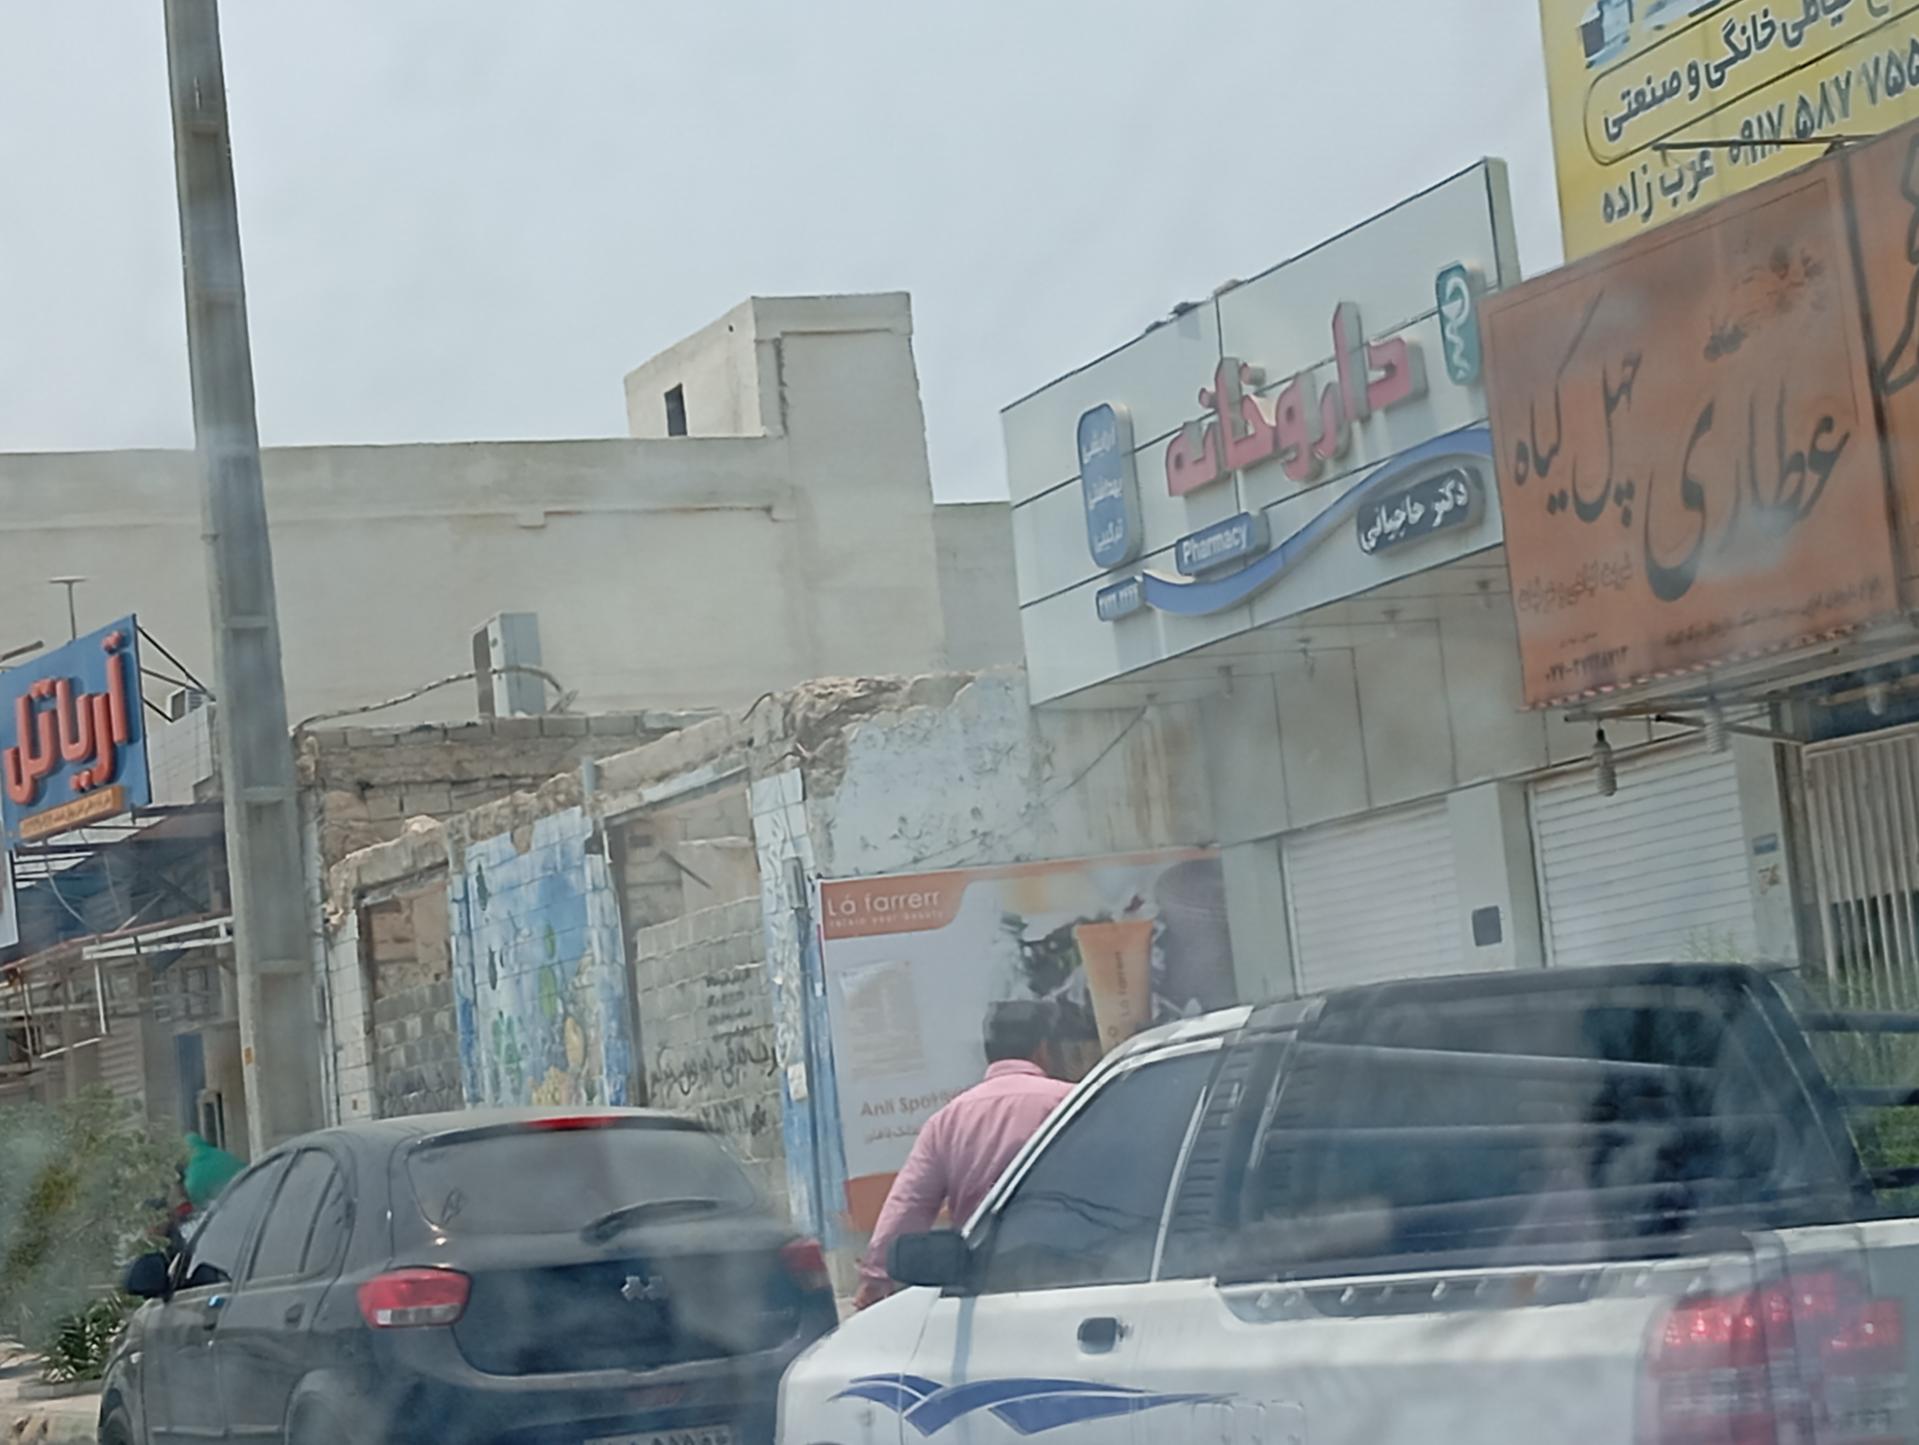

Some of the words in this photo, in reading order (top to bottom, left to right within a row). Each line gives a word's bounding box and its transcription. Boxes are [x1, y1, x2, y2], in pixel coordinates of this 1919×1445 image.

[1704, 8, 1777, 88] خانگی
[1603, 71, 1683, 143] صنعتی
[1687, 60, 1701, 102] و
[1795, 70, 1852, 140] ۵۸۷
[1602, 163, 1653, 224] زاده
[1658, 149, 1715, 208] عرب
[1166, 301, 1418, 496] داروخانه
[1432, 479, 1468, 528] دکتر
[1644, 373, 1851, 602] عطاری
[1183, 522, 1248, 565] Pharmacy
